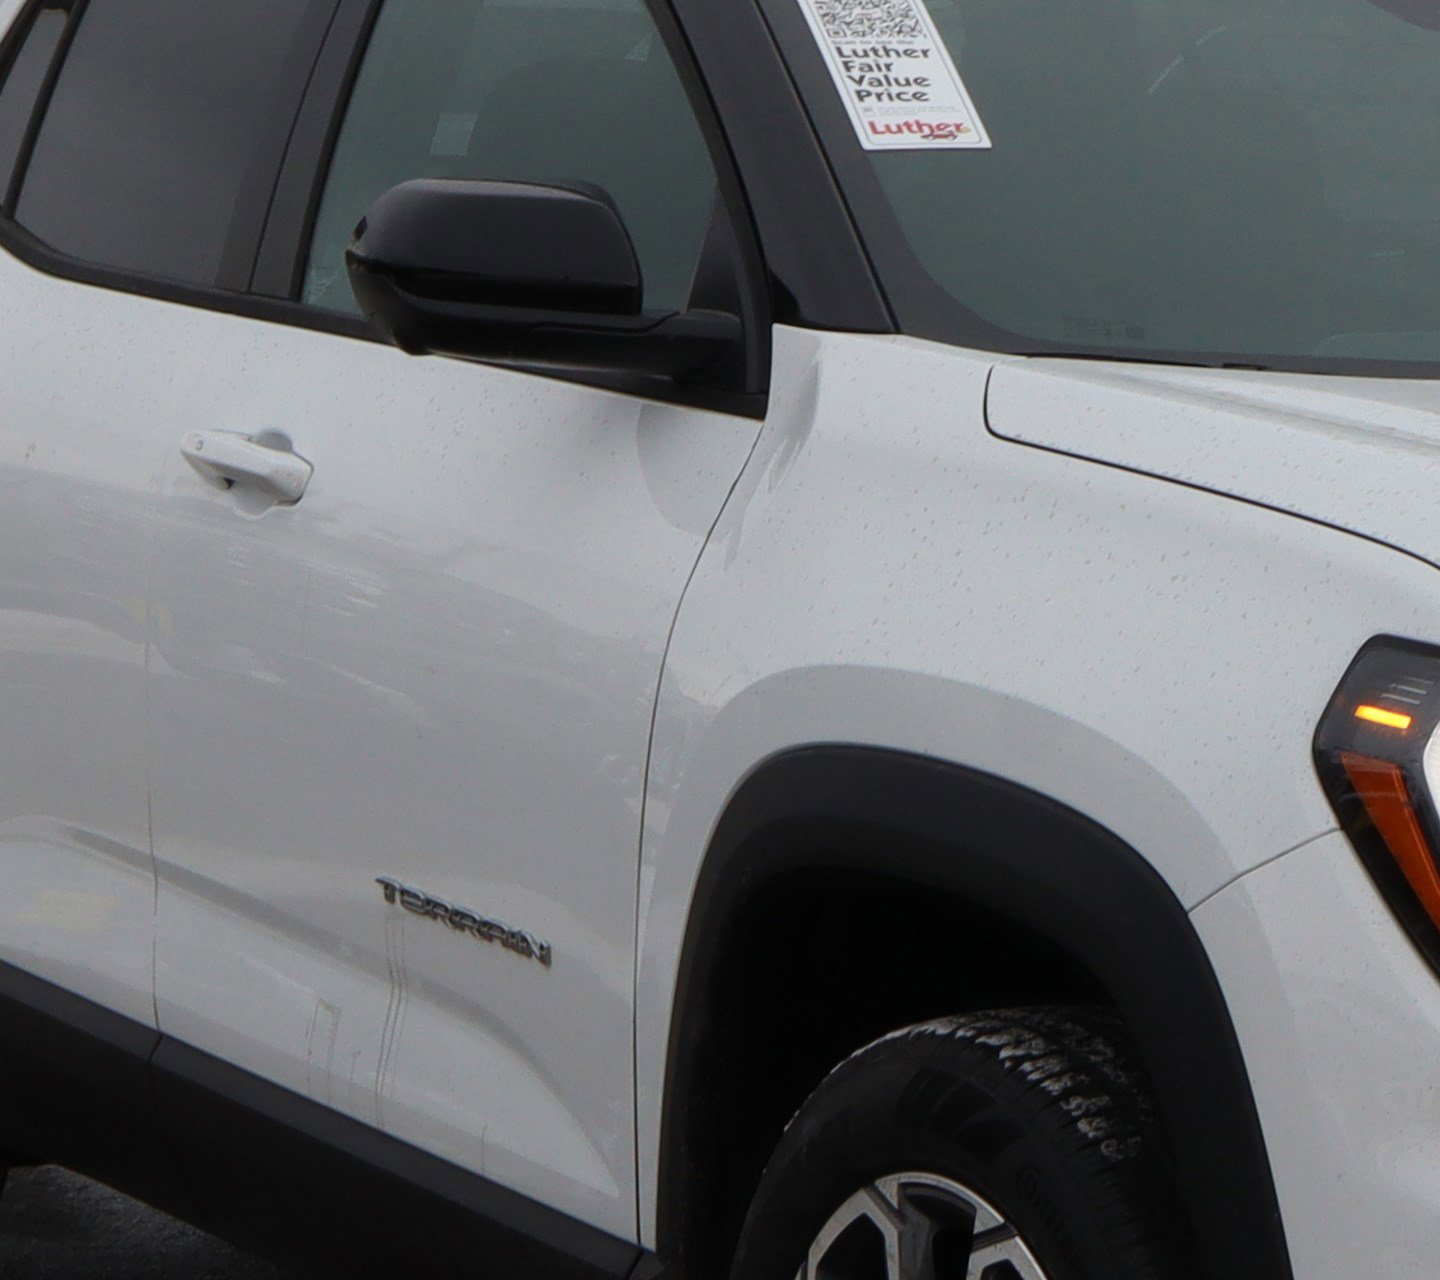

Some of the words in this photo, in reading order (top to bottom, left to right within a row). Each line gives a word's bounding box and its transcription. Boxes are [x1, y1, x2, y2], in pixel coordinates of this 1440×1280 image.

[835, 45, 931, 59] Luther
[841, 58, 894, 73] Fair
[846, 74, 931, 88] Value
[854, 88, 930, 103] Price
[867, 119, 965, 136] Luther
[375, 874, 553, 969] TERRAIN
